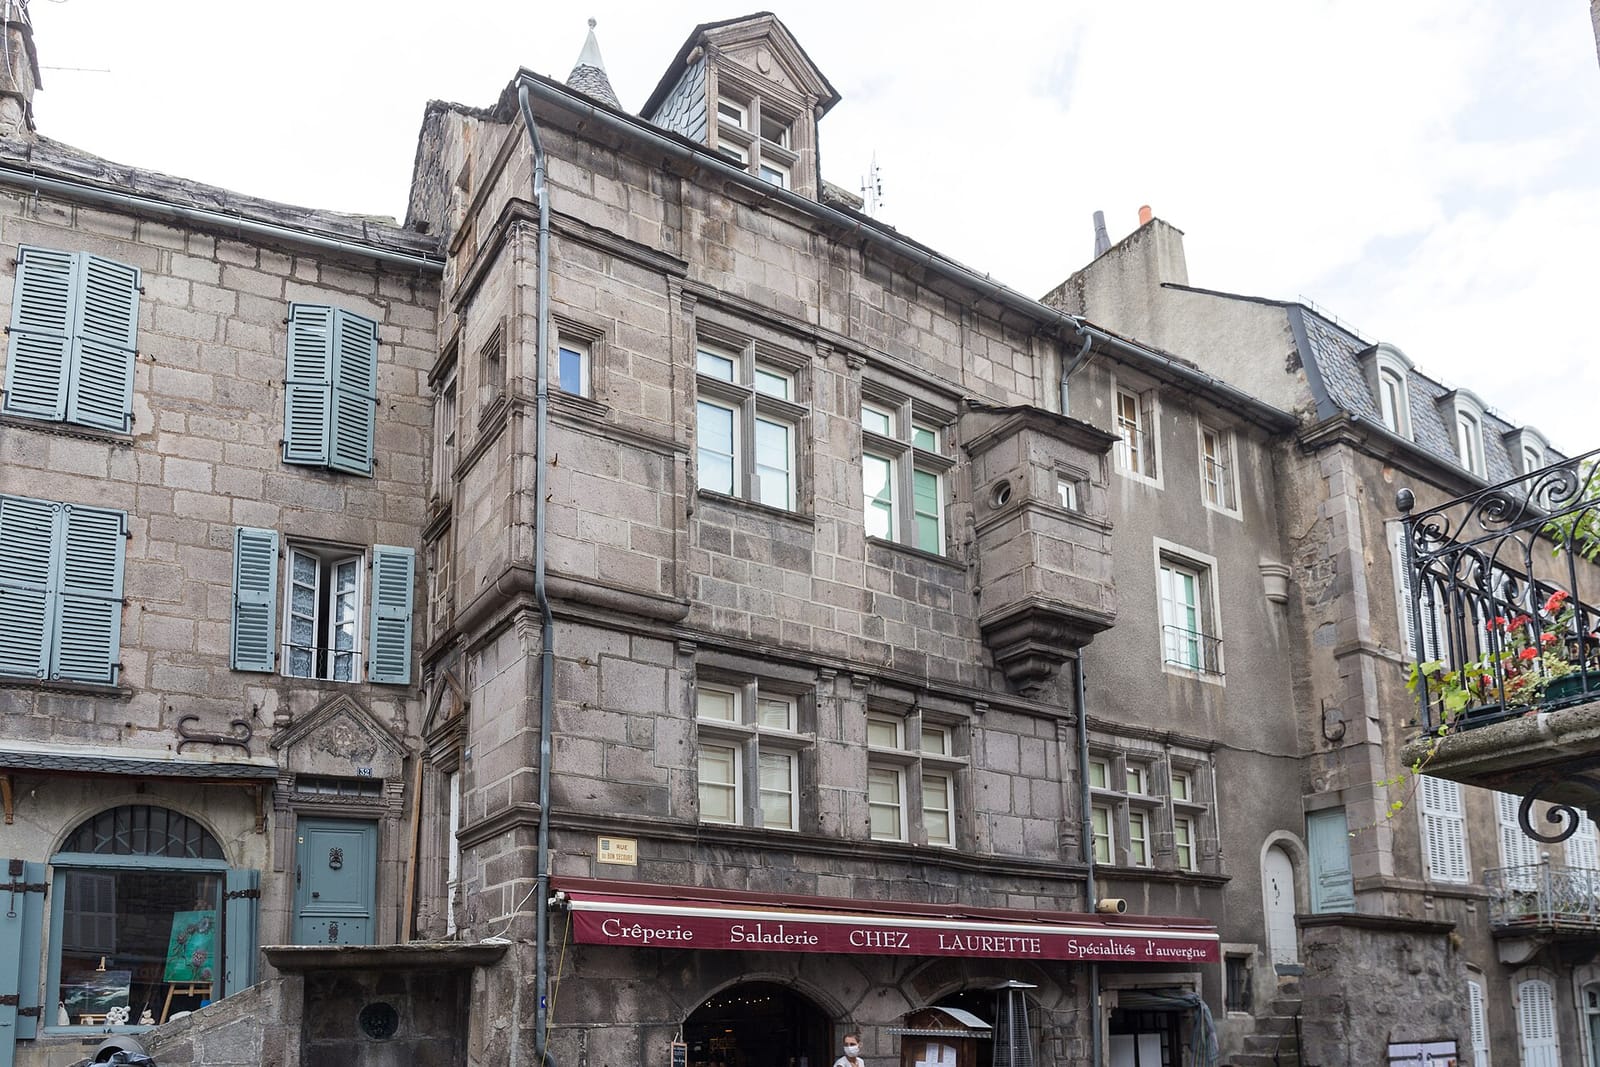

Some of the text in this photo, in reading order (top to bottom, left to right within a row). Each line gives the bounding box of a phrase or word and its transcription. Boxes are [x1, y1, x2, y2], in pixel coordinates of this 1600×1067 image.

[360, 768, 370, 776] 32
[601, 918, 1207, 959] Crêperie Saladerie CHEZ LAURETTE Spécialités d'auvergne
